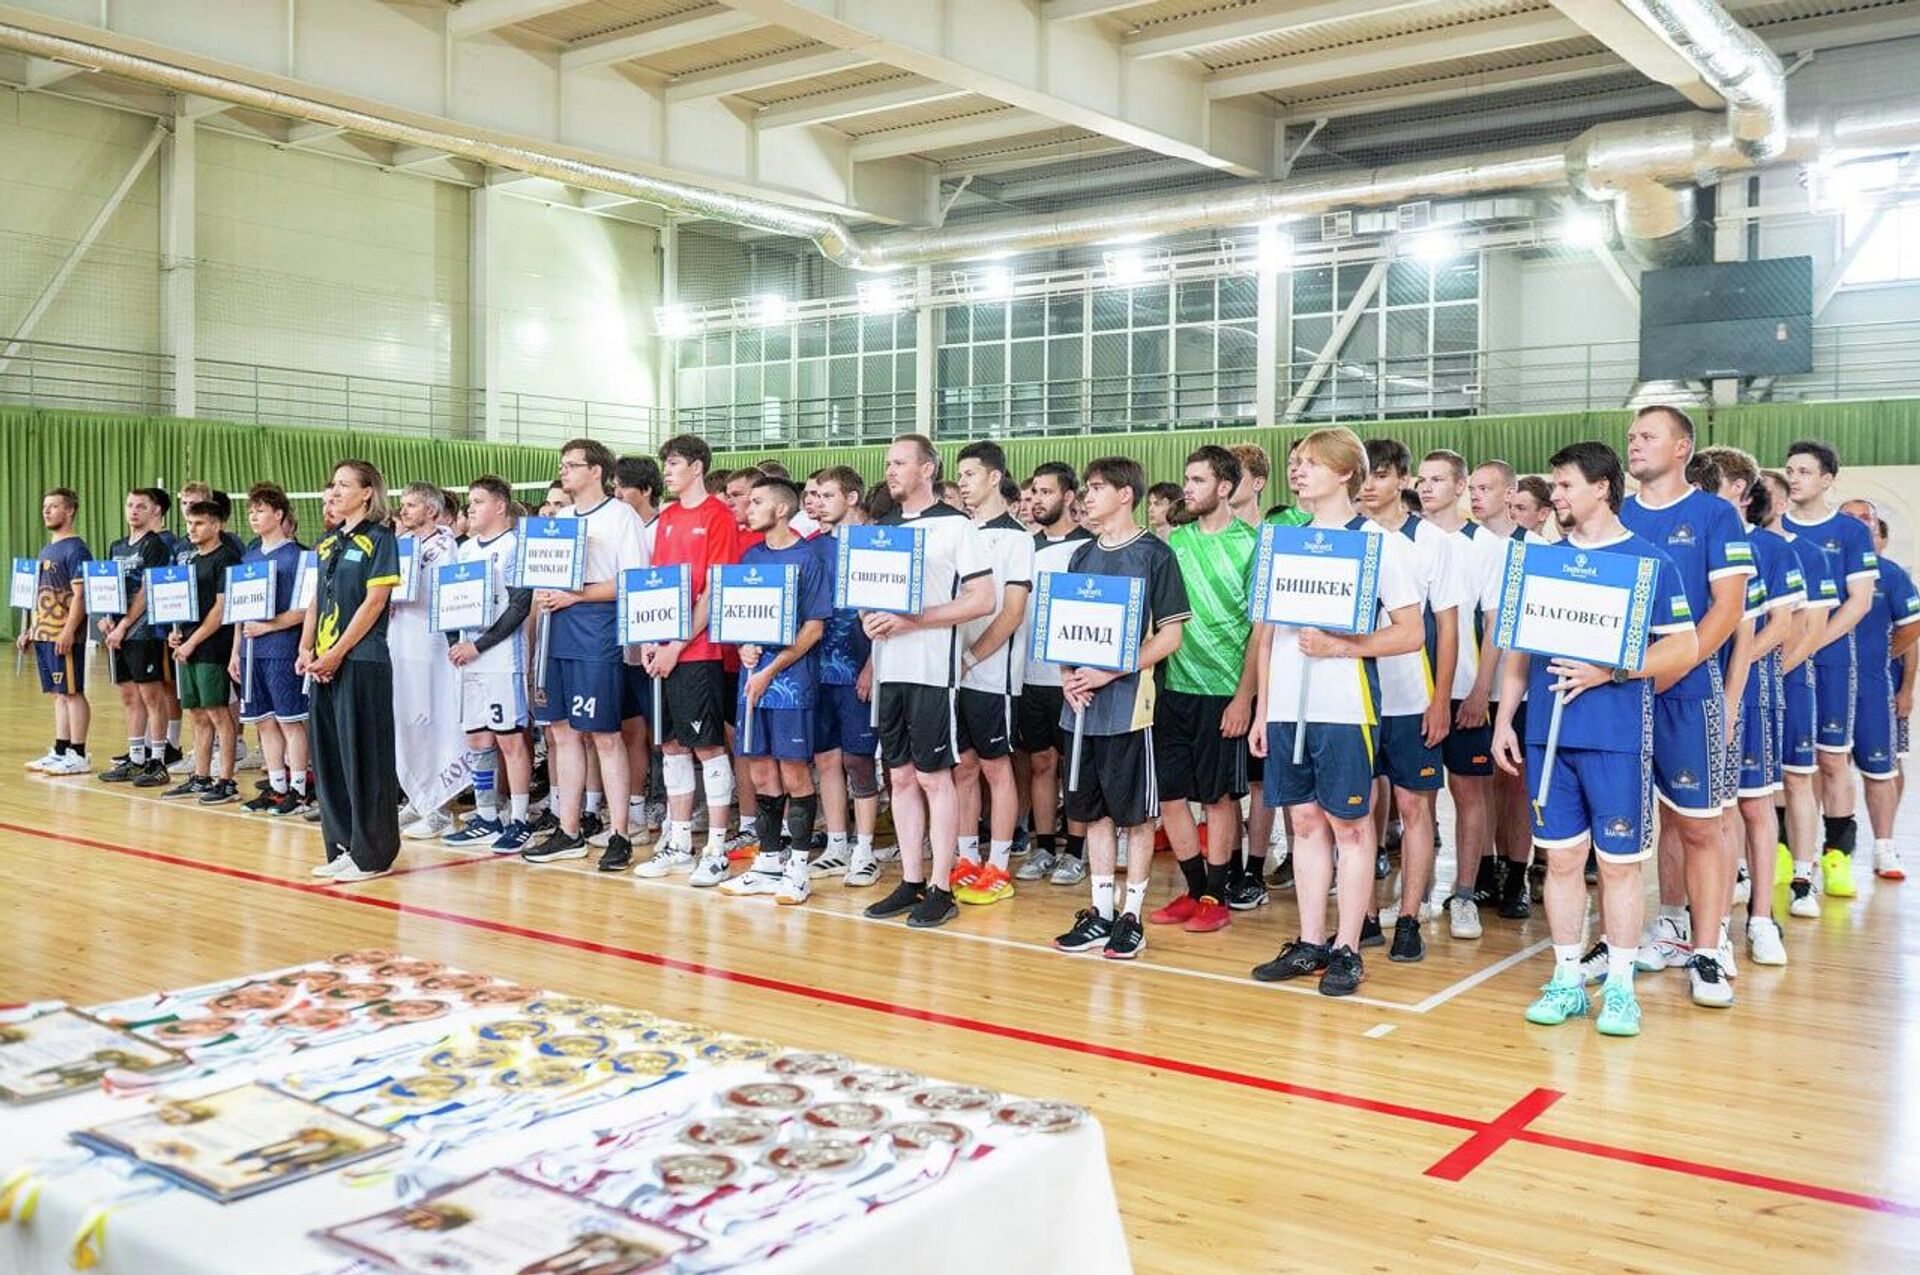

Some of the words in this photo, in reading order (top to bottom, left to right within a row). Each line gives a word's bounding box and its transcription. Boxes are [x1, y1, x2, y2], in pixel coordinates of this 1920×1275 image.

[528, 548, 571, 559] ПЕРЕСВЕТ
[851, 571, 907, 585] СИНЕРГИЯ
[1275, 577, 1354, 597] БИШКЕК
[630, 606, 677, 624] ЛОГОС
[723, 603, 780, 619] ЖЕНИС
[1525, 602, 1623, 630] БЛАГОВЕСТ
[1057, 624, 1113, 646] АПМД
[489, 703, 504, 724] 3
[571, 695, 598, 719] 24
